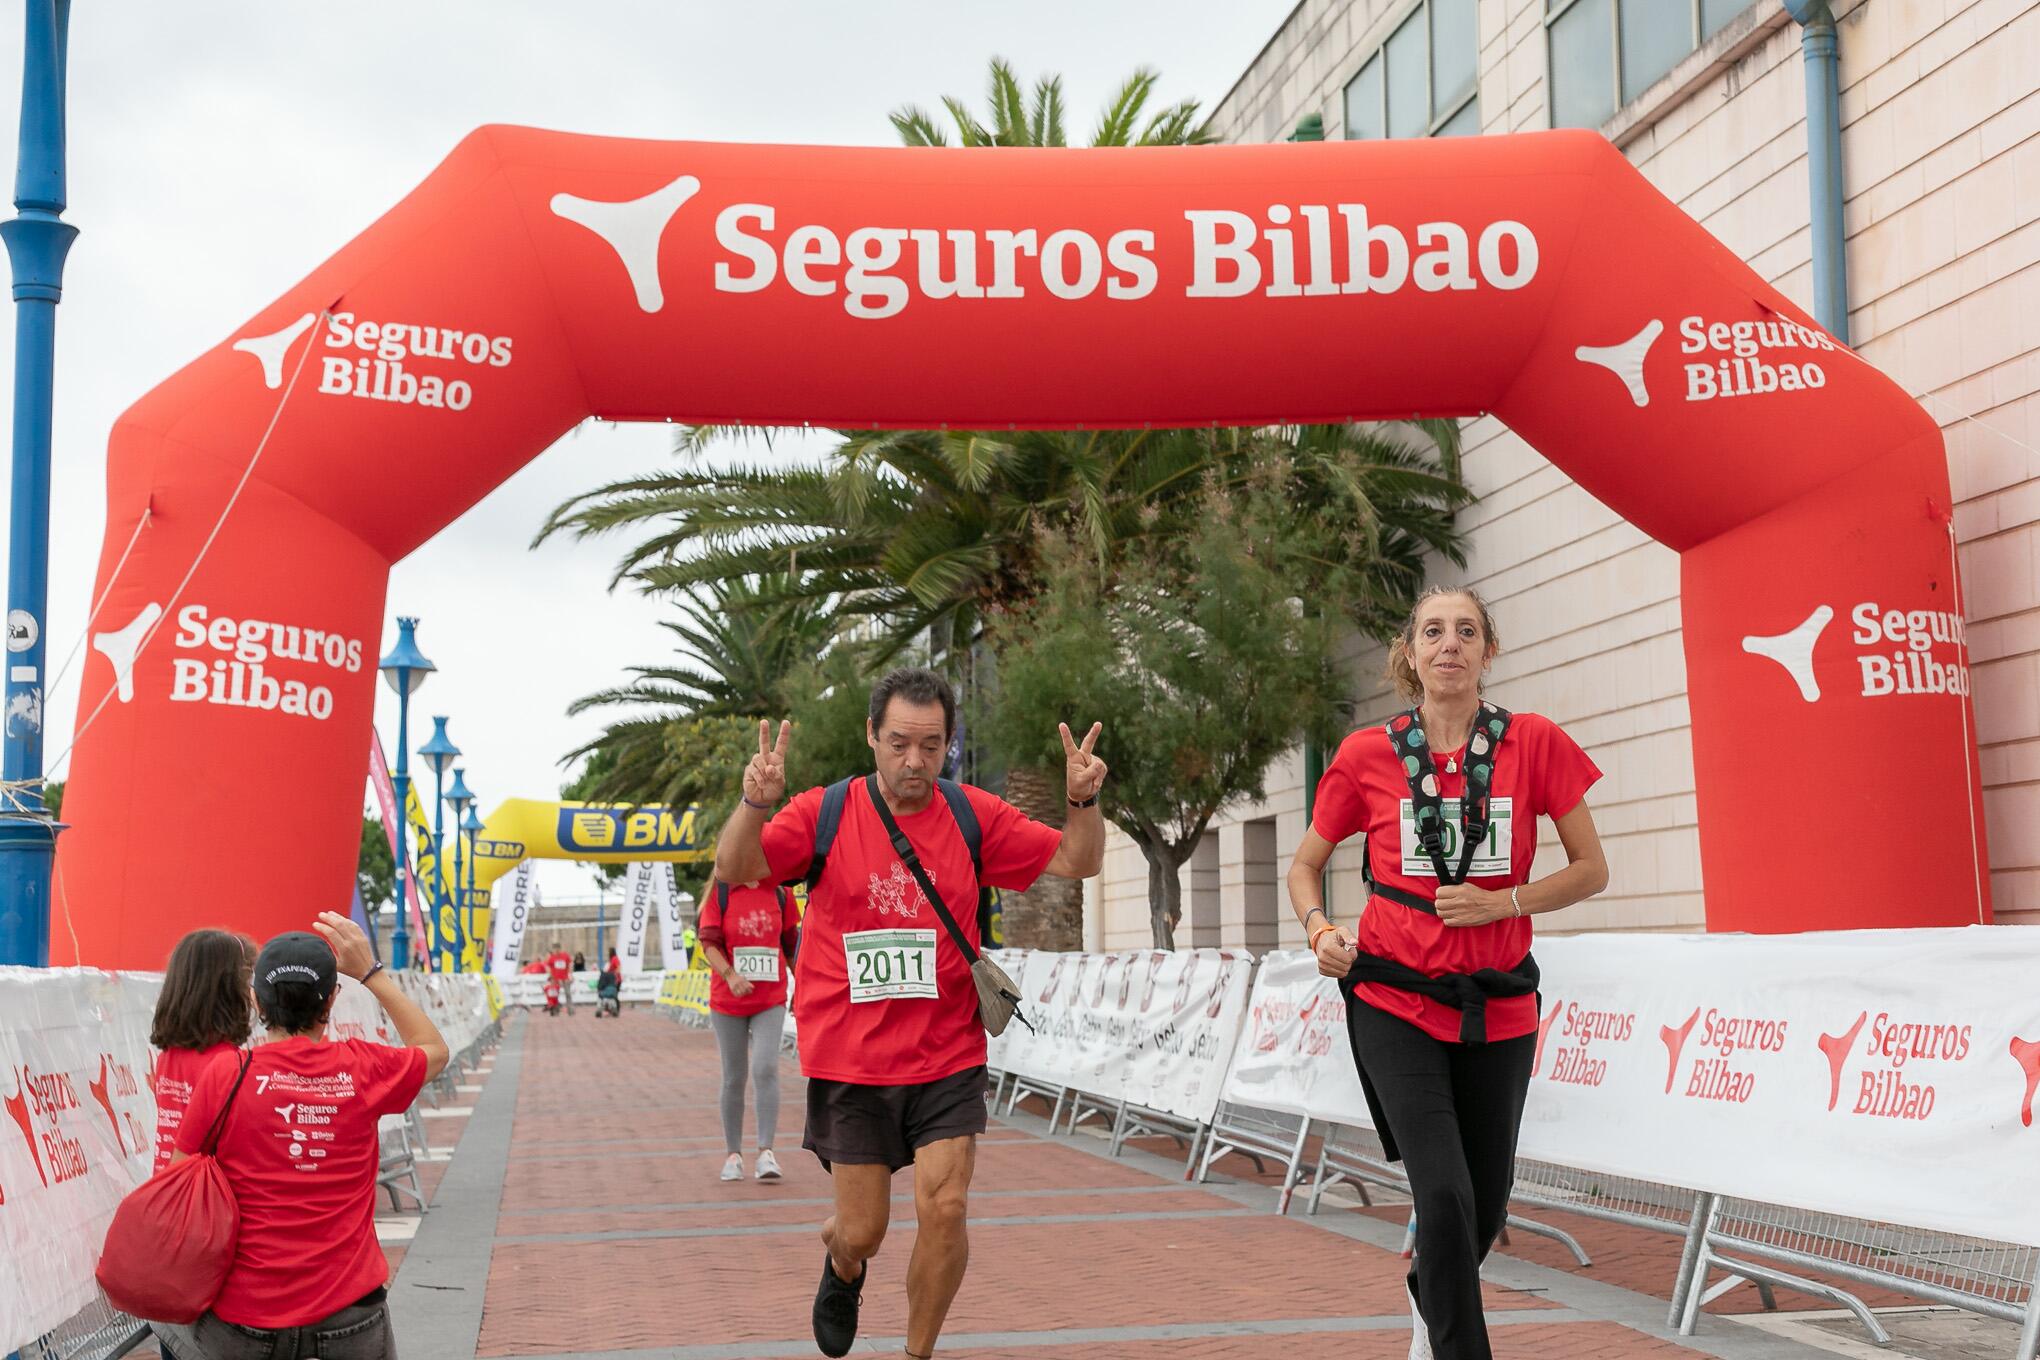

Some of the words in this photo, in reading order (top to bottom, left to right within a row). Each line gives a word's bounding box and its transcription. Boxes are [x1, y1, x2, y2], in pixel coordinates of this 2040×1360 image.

[713, 203, 1158, 319] Seguros
[1184, 203, 1540, 299] Bilbao
[325, 311, 512, 368] Seguros
[1679, 315, 1835, 358] Seguros
[319, 356, 473, 411] Bilbao
[1684, 356, 1826, 401] Bilbao
[175, 604, 362, 673] Seguros
[169, 656, 333, 720] Bilbao
[1856, 650, 1970, 697] Bilbao
[493, 842, 521, 857] BM
[623, 810, 697, 847] BM
[504, 938, 521, 962] EL
[627, 936, 641, 957] EL
[739, 956, 772, 973] 2011
[856, 949, 923, 985] 2011
[1562, 1001, 1635, 1046] Seguros
[1700, 1007, 1789, 1057] Seguros
[1866, 1010, 1972, 1069] Seguros
[1548, 1047, 1608, 1087] Bilbao
[1684, 1058, 1756, 1104] Bilbao
[296, 1103, 338, 1116] Seguros
[1851, 1070, 1936, 1121] Bilbao
[296, 1113, 331, 1124] Bilbao
[41, 1127, 89, 1184] Bilbao
